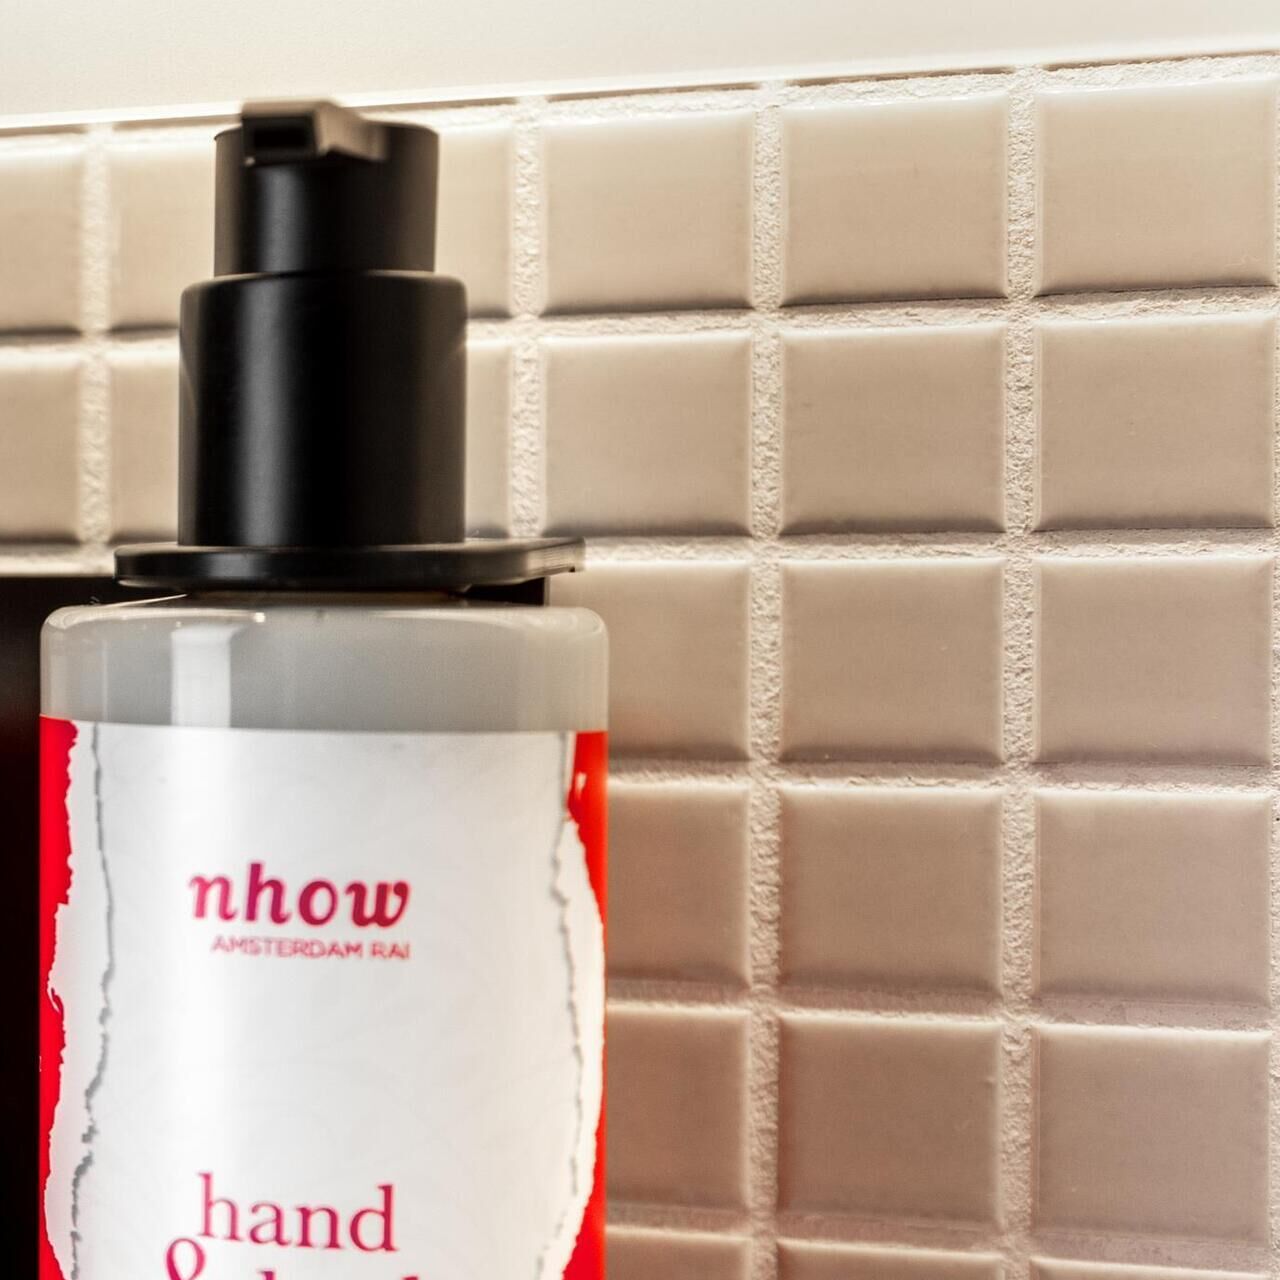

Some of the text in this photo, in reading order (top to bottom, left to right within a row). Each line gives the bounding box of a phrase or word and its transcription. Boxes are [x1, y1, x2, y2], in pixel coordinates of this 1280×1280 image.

[190, 861, 411, 928] nhow
[210, 935, 411, 960] AMSTERDAM RAI
[198, 1171, 398, 1254] hand
